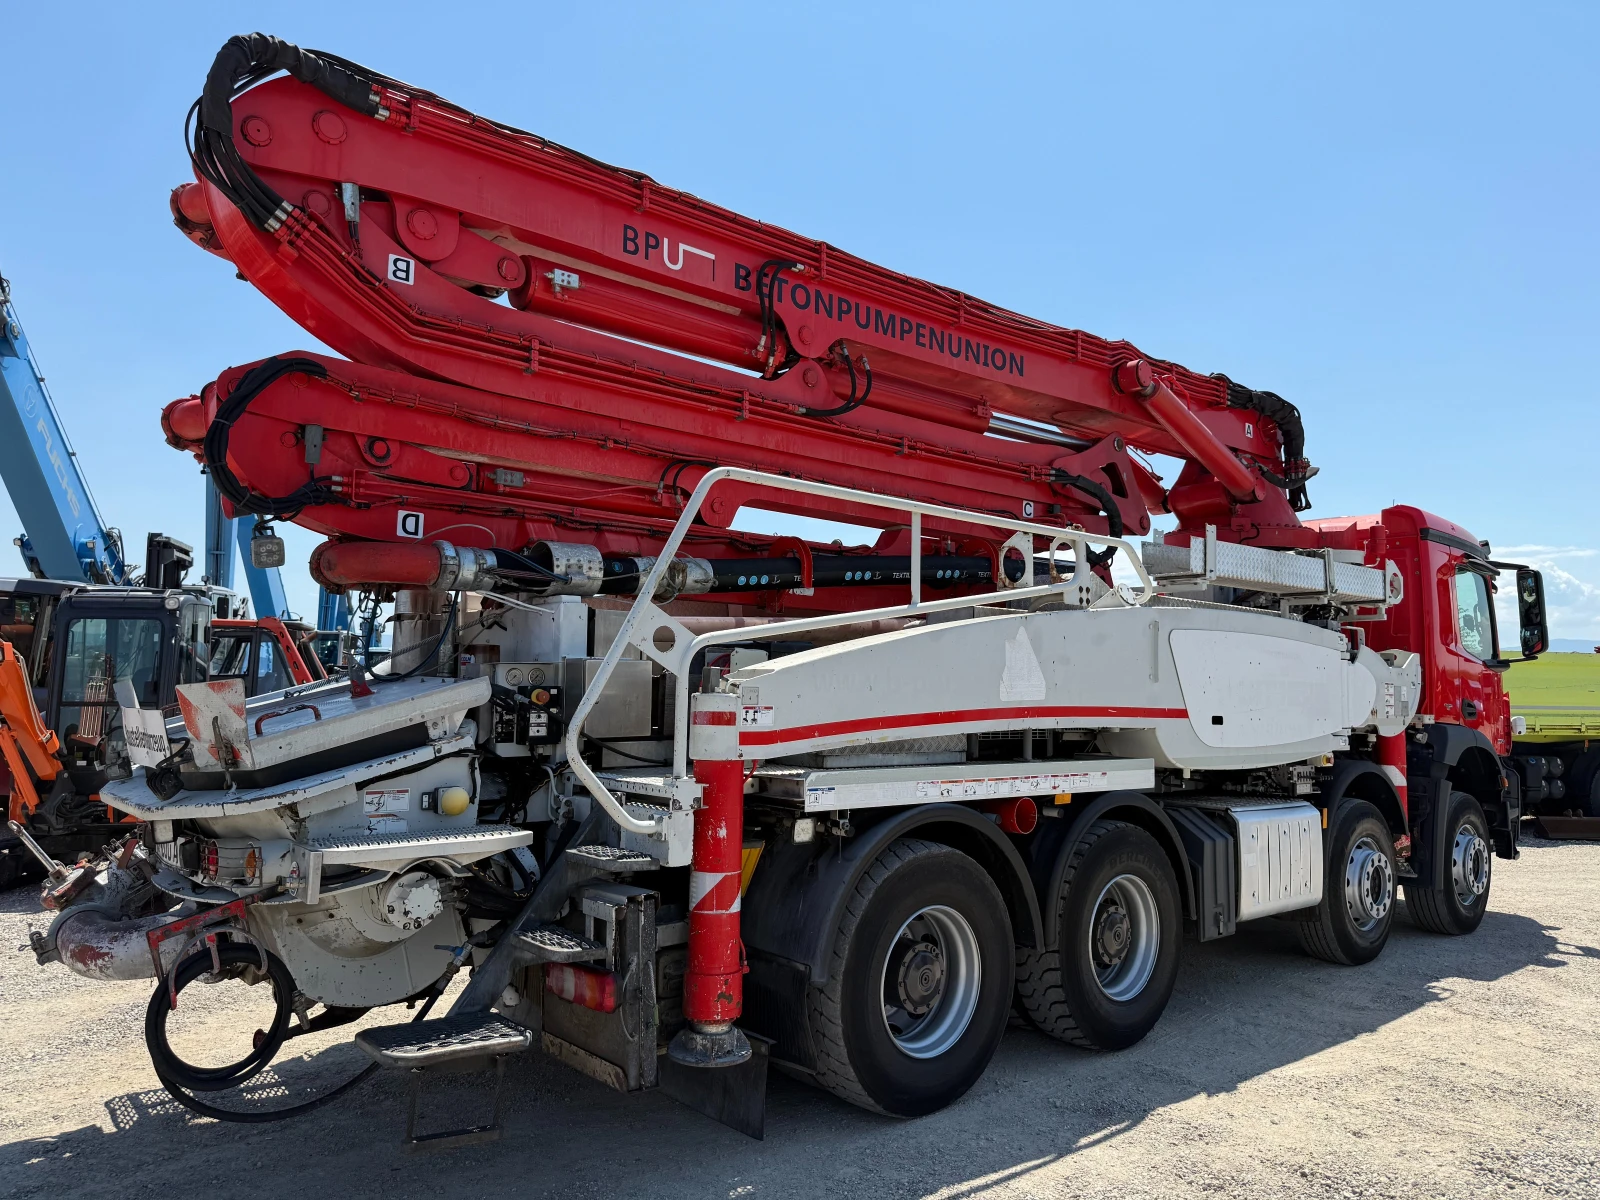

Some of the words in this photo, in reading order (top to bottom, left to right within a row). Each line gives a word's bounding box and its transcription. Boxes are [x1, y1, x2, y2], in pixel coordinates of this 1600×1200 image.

[392, 257, 411, 283] B
[623, 224, 715, 273] BPU
[735, 261, 1025, 378] BETONPUMPENUNION
[1246, 424, 1252, 436] A
[37, 416, 81, 519] FUCHS
[1024, 502, 1033, 517] C
[402, 513, 420, 536] D
